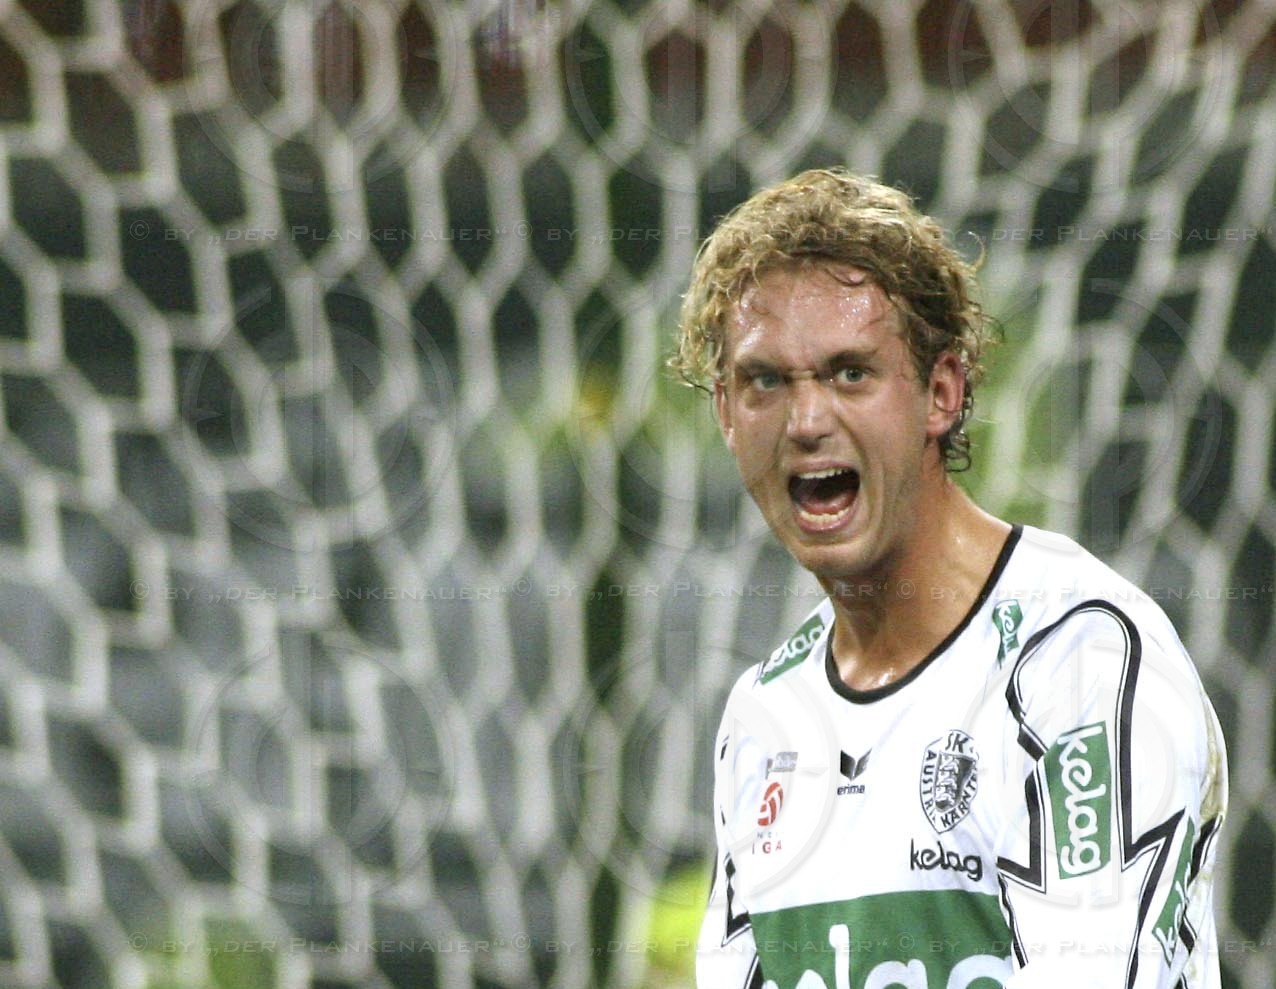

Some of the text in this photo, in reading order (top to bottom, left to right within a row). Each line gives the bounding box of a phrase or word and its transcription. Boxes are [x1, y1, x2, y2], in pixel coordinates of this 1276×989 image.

[944, 732, 970, 754] SK
[836, 784, 866, 796] erima
[1056, 725, 1108, 875] kelag
[910, 837, 984, 882] kelag
